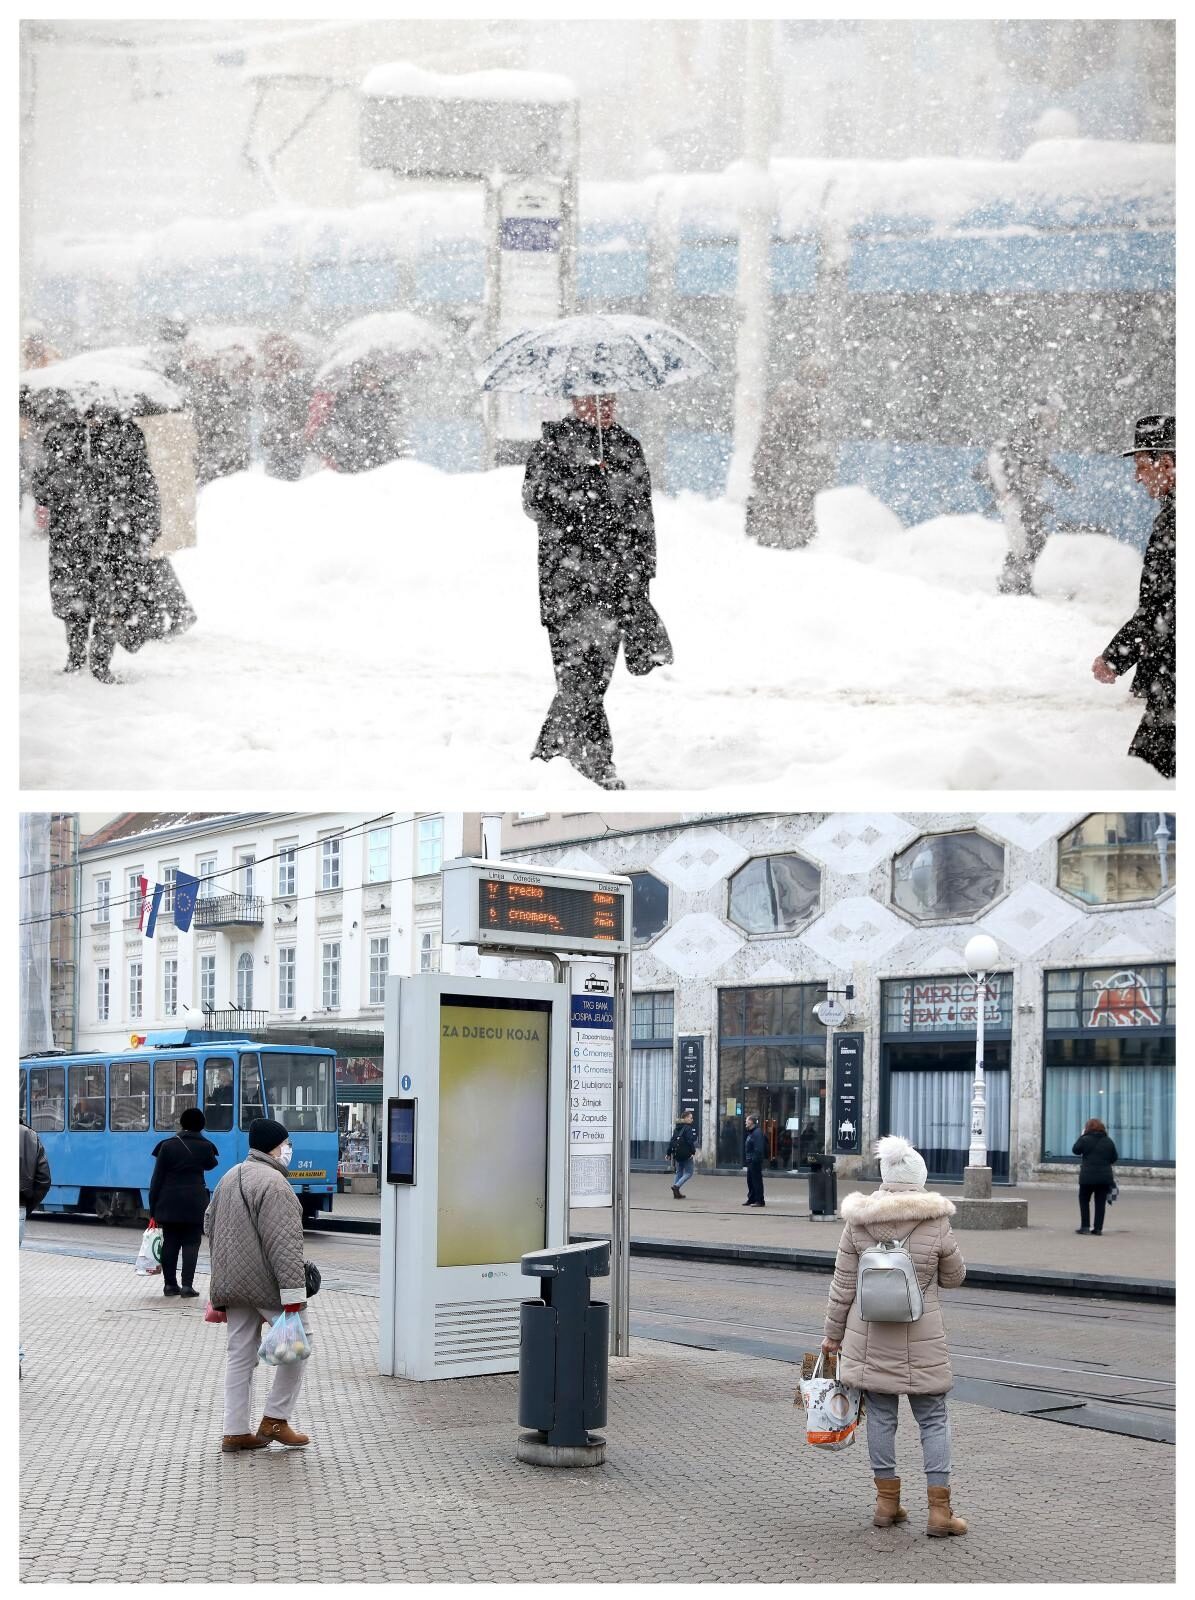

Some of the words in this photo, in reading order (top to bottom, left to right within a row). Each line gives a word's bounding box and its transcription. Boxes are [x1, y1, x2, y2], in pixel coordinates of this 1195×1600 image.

[583, 1000, 594, 1010] TRG
[903, 1007, 942, 1024] STEAK
[442, 1024, 459, 1038] ZA
[462, 1025, 503, 1040] DJECU
[506, 1028, 540, 1042] KOJA
[576, 1031, 580, 1042] 1
[573, 1047, 580, 1057] 6
[572, 1130, 581, 1140] 17
[297, 1160, 313, 1169] 341
